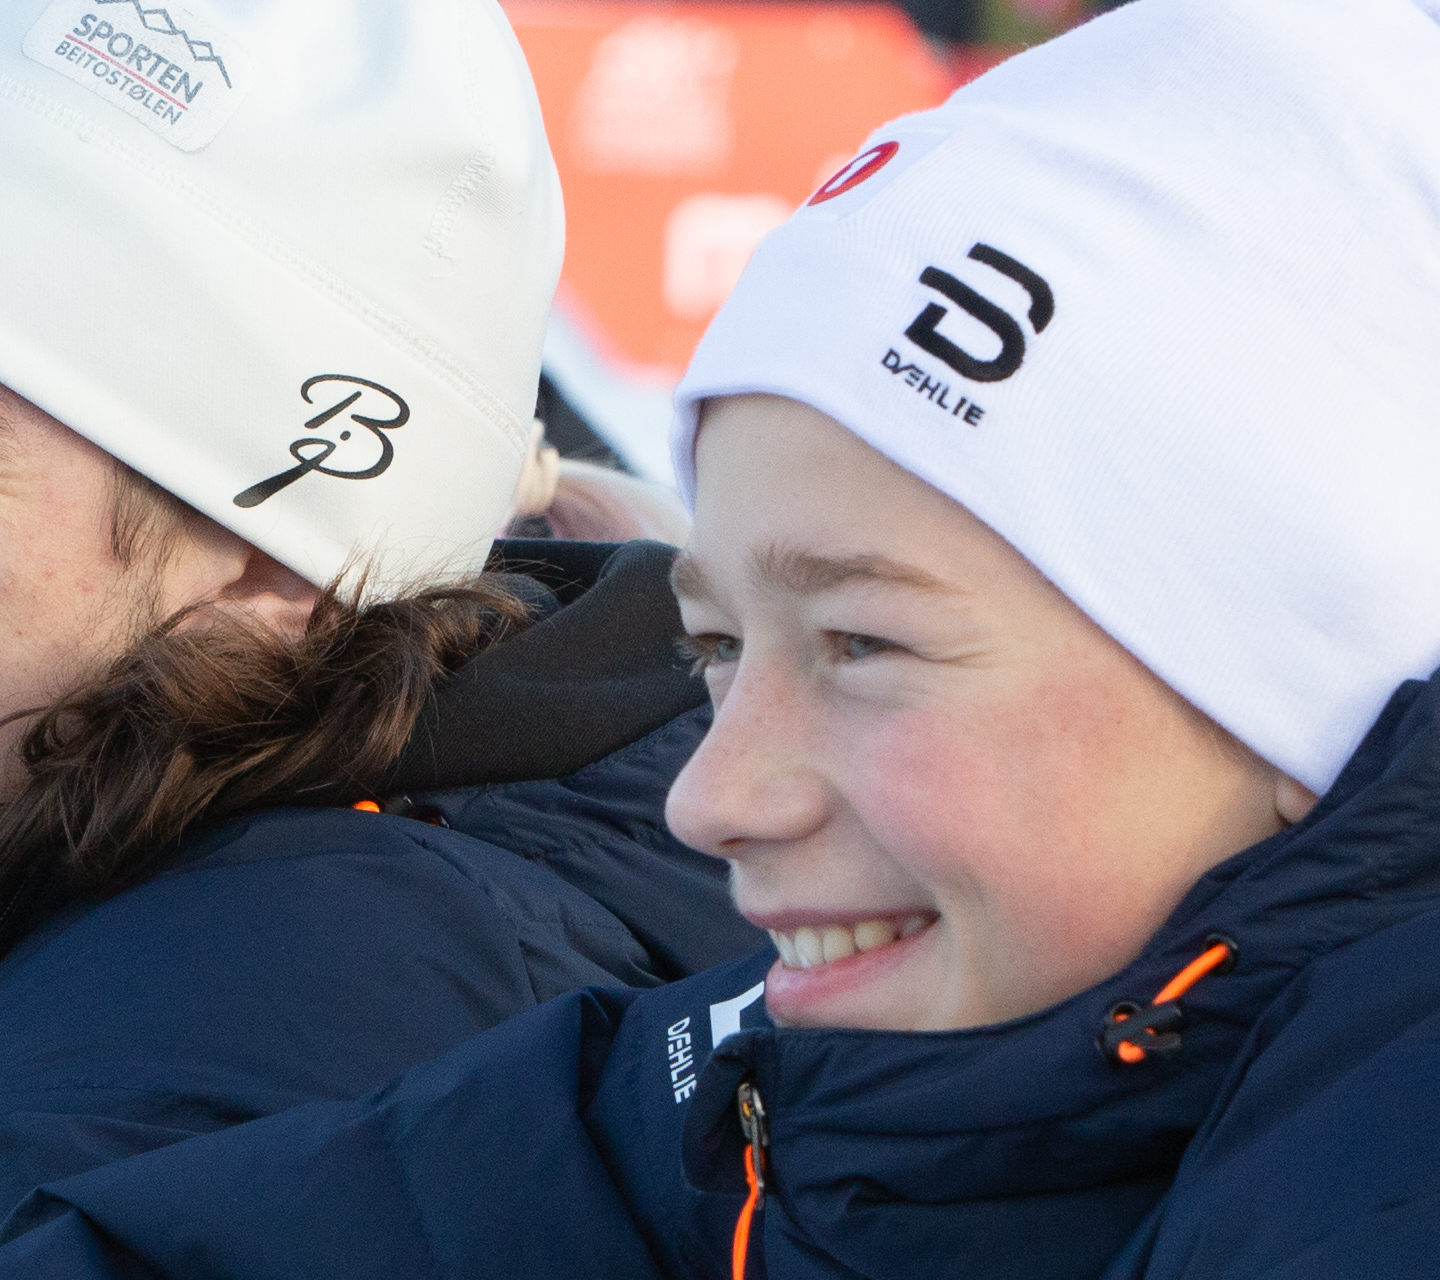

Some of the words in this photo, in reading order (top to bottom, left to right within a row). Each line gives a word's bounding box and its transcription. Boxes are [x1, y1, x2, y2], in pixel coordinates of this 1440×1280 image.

[54, 39, 183, 126] BEITOSTØLEN
[73, 13, 203, 104] SPORTEN
[880, 349, 986, 427] DÆHLIE
[667, 1016, 697, 1104] DÆHLIE
